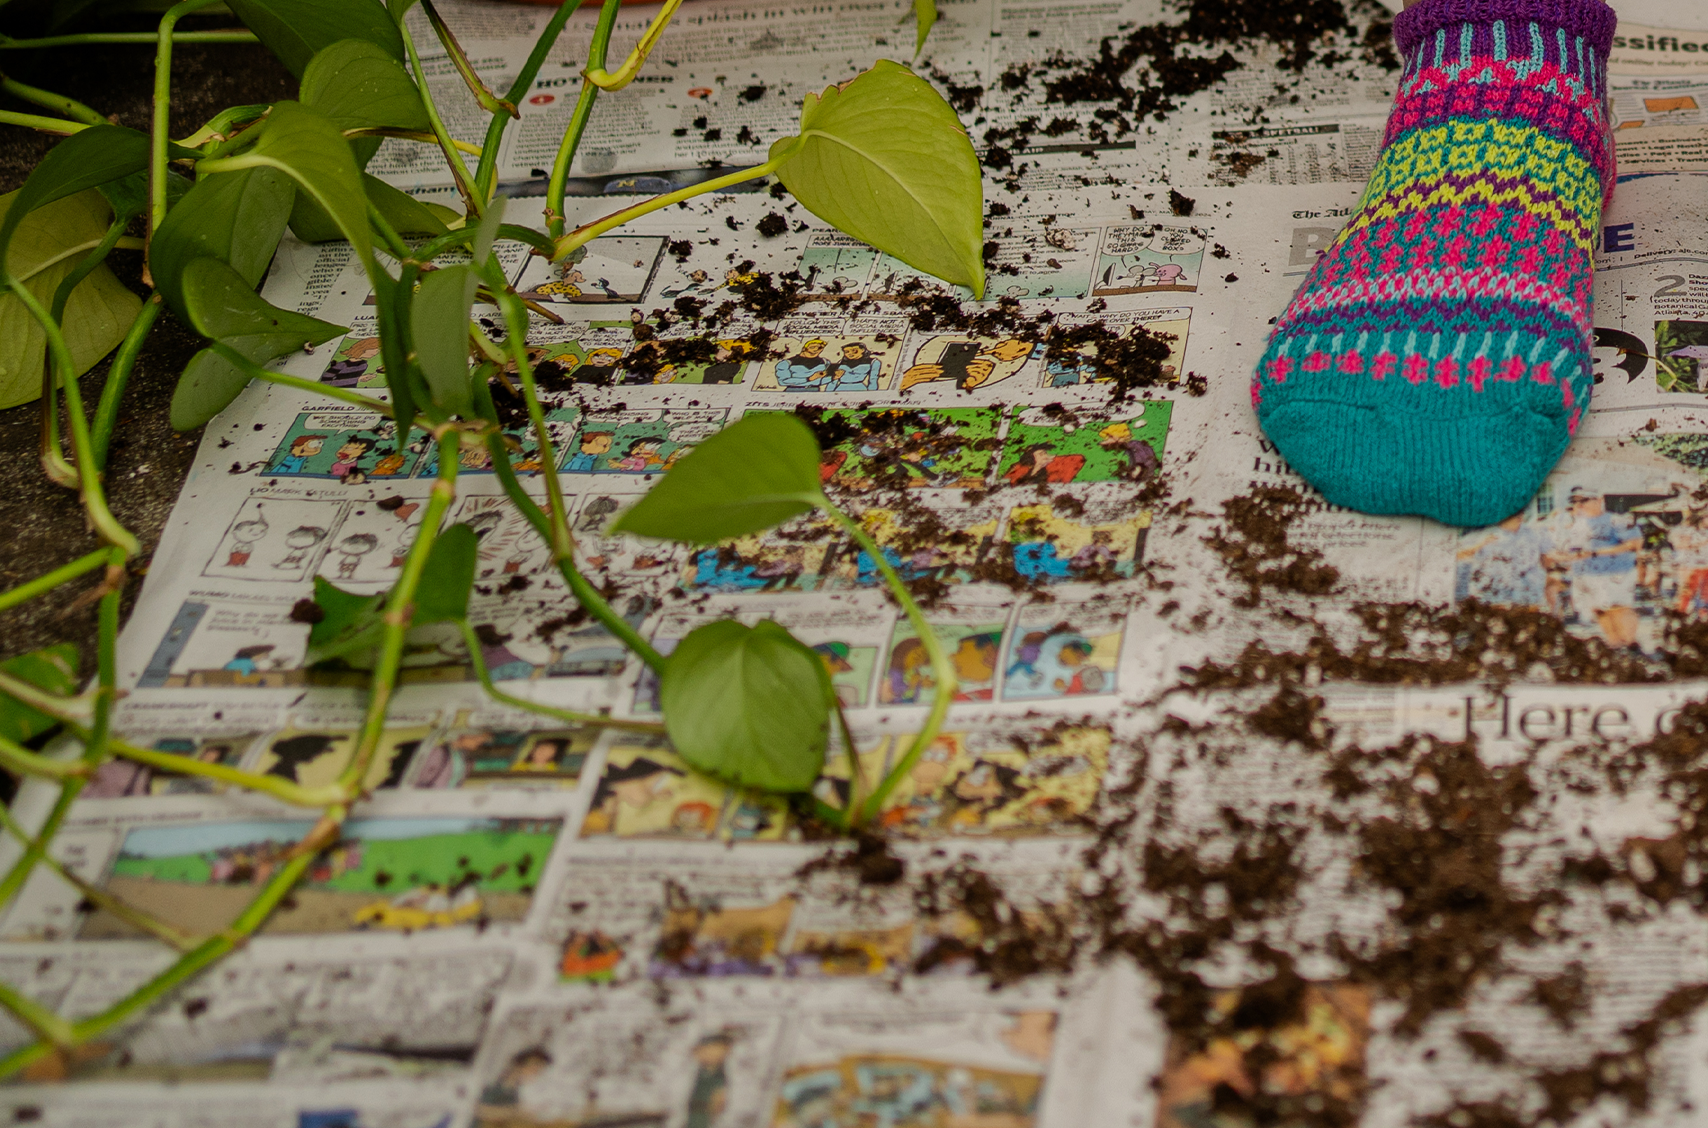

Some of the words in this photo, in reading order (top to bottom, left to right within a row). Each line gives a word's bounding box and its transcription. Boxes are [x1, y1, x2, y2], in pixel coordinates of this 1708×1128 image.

[1292, 210, 1321, 219] The
[1653, 274, 1687, 298] 2
[1464, 696, 1630, 741] Here
